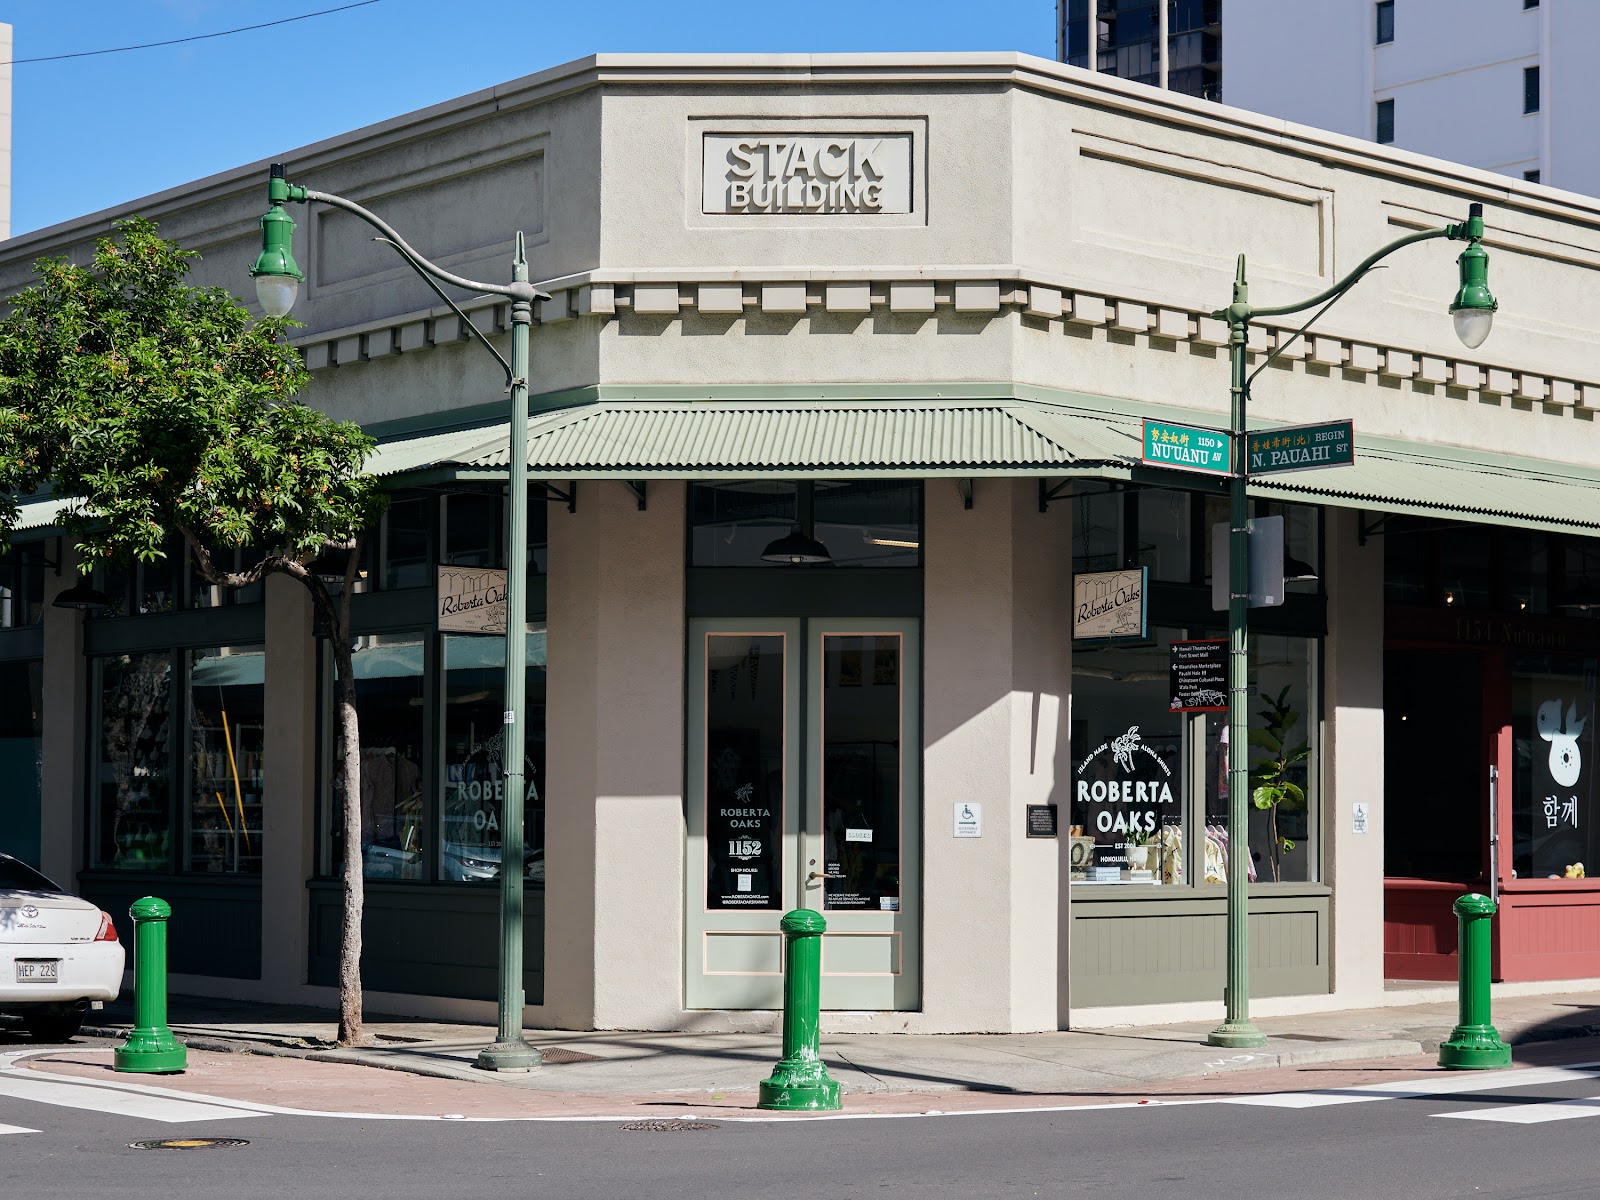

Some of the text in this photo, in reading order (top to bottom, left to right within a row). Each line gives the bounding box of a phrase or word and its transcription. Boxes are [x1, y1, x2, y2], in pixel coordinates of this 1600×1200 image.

[726, 140, 884, 178] STACK
[728, 180, 883, 209] BUILDING
[1197, 436, 1215, 448] 1150
[1315, 430, 1345, 442] BEGIN
[1151, 442, 1223, 465] NU'UANU AV
[1252, 443, 1349, 468] N. PAUAHI ST
[441, 583, 507, 616] Roberta Oak
[1077, 583, 1140, 623] Roberta Oaks
[1077, 742, 1172, 777] ISLAND MADE ALOHA SHIRTS
[458, 780, 539, 801] ROBEA
[1077, 780, 1174, 803] ROBERTA
[473, 809, 499, 831] OA
[720, 808, 771, 817] ROBERTA
[1096, 810, 1156, 833] OAKS
[1542, 794, 1578, 829] 함께
[729, 819, 761, 828] OAKS
[728, 840, 762, 856] 1152
[1100, 855, 1129, 863] HONOLULU,
[18, 965, 56, 977] HEP 228
